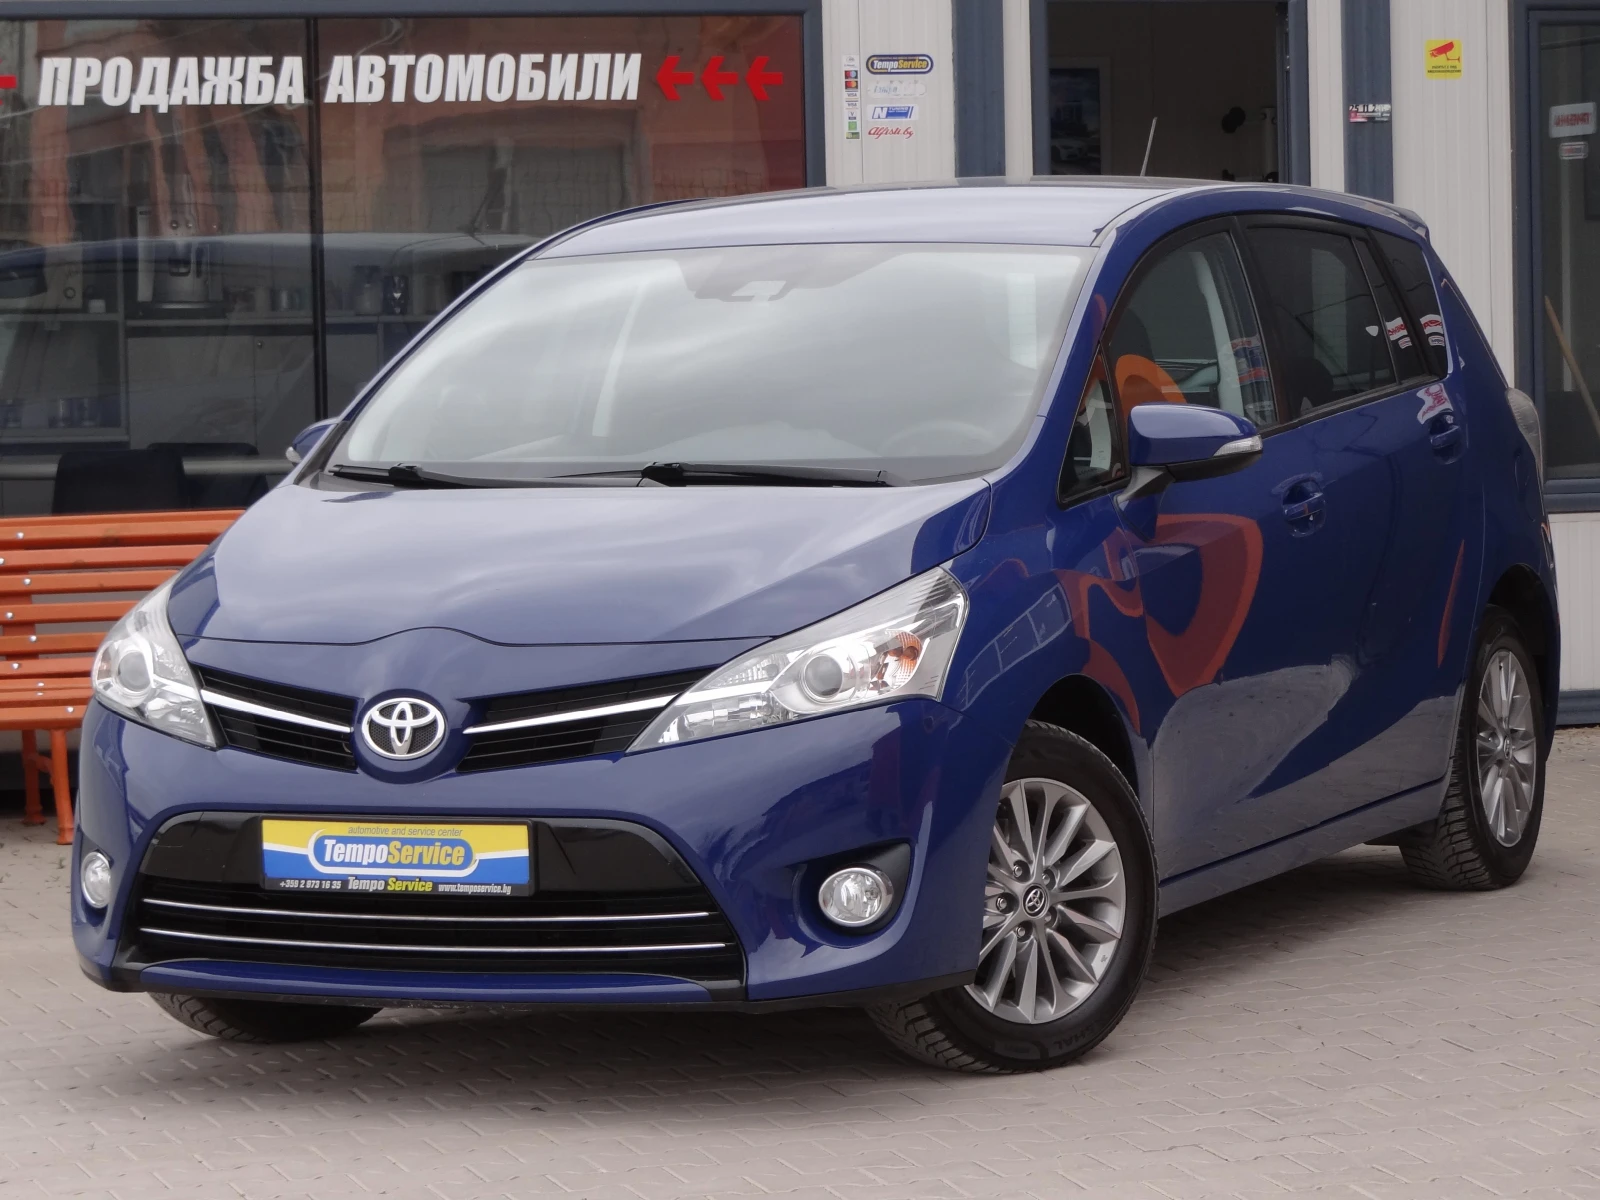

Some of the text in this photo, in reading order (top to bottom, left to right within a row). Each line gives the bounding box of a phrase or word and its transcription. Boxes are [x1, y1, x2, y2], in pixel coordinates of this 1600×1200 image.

[873, 59, 928, 72] TempoService
[38, 53, 643, 113] ПРОДАЖБА АВТОМОБИЛИ
[348, 826, 464, 837] automotive and service center
[323, 839, 465, 865] TempoService
[300, 880, 305, 888] 2
[322, 881, 330, 889] 16
[331, 881, 342, 889] 35
[348, 877, 433, 892] Tempo Service
[438, 884, 512, 895] www.temposervice.bg
